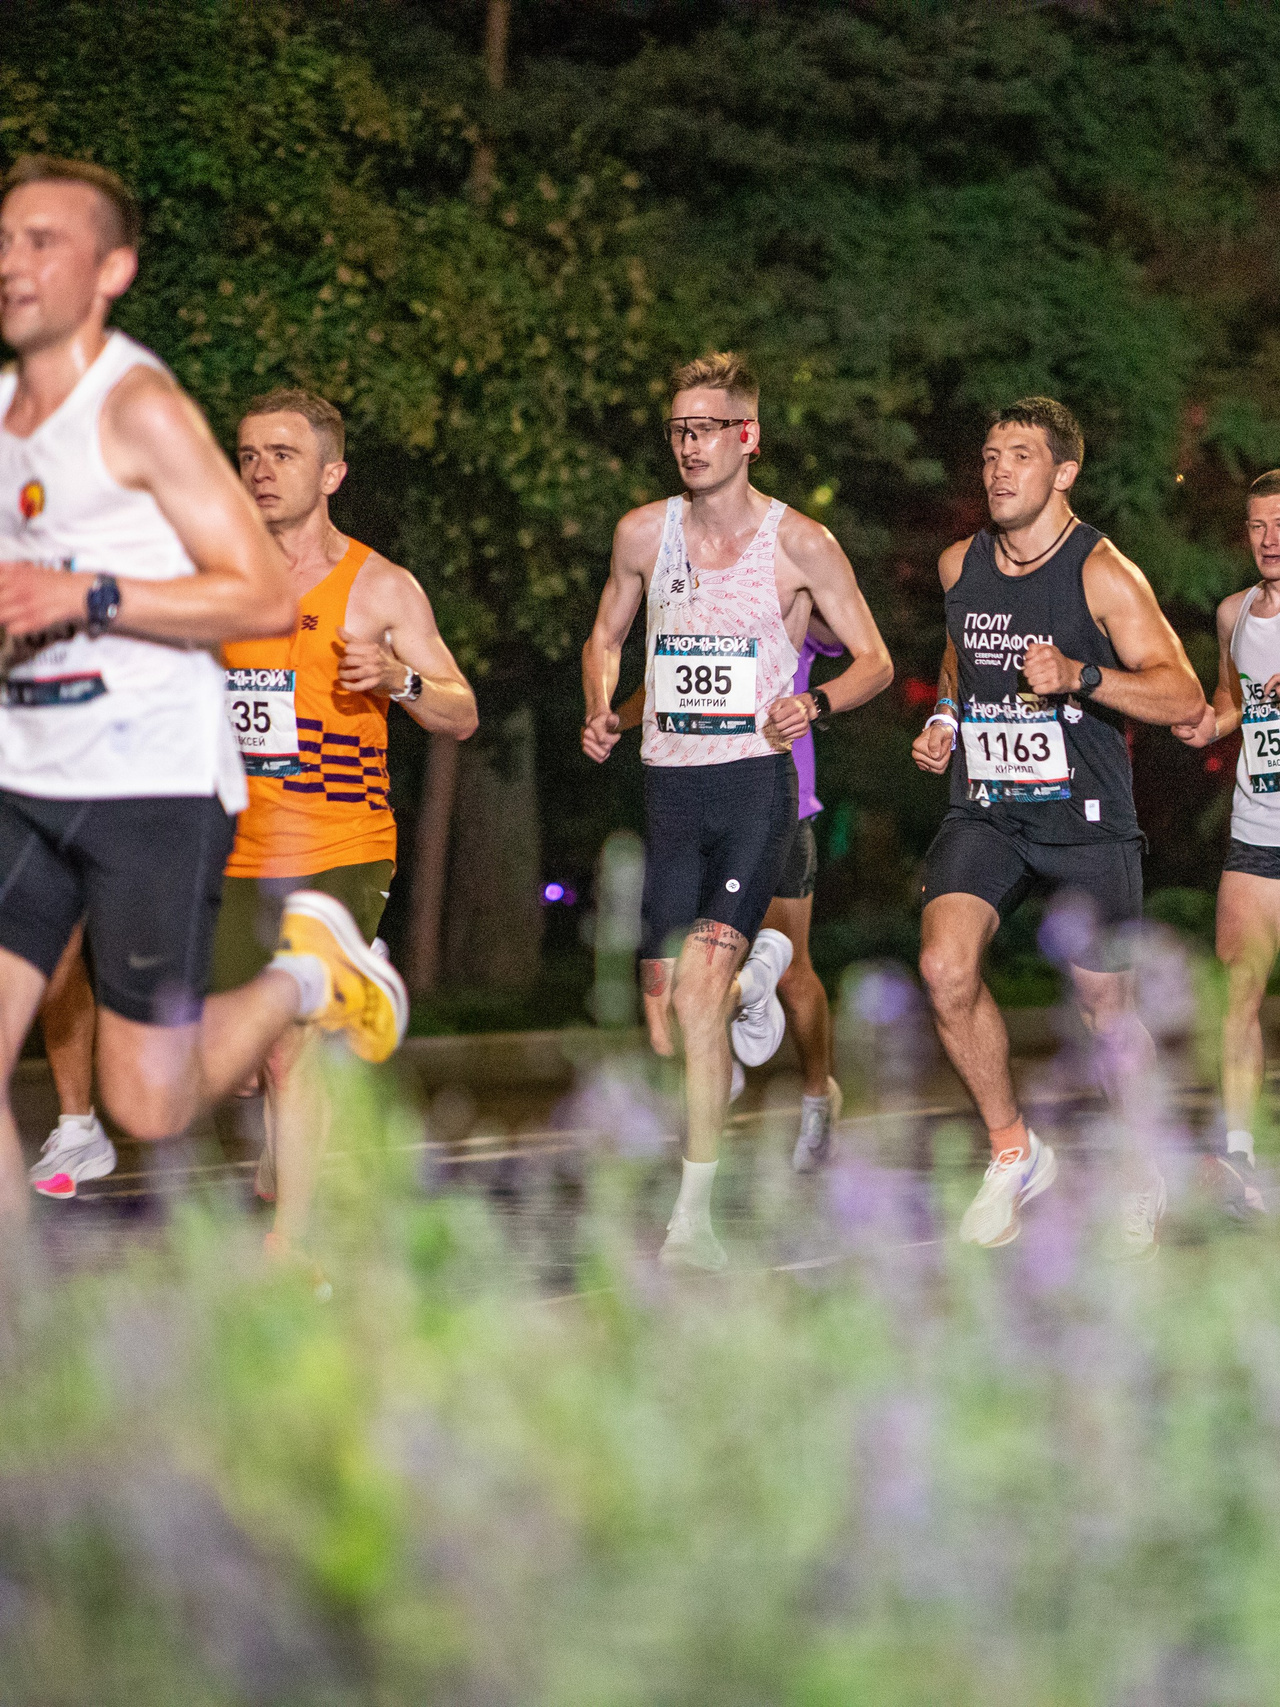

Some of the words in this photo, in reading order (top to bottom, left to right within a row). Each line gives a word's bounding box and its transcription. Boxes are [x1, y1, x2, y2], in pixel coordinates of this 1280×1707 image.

[964, 613, 1012, 631] ПОЛУ
[963, 632, 1054, 651] МАРАФОН
[676, 665, 732, 695] 385
[679, 697, 727, 708] ДМИТРИЙ
[231, 701, 271, 733] 35
[977, 731, 1051, 762] 1163
